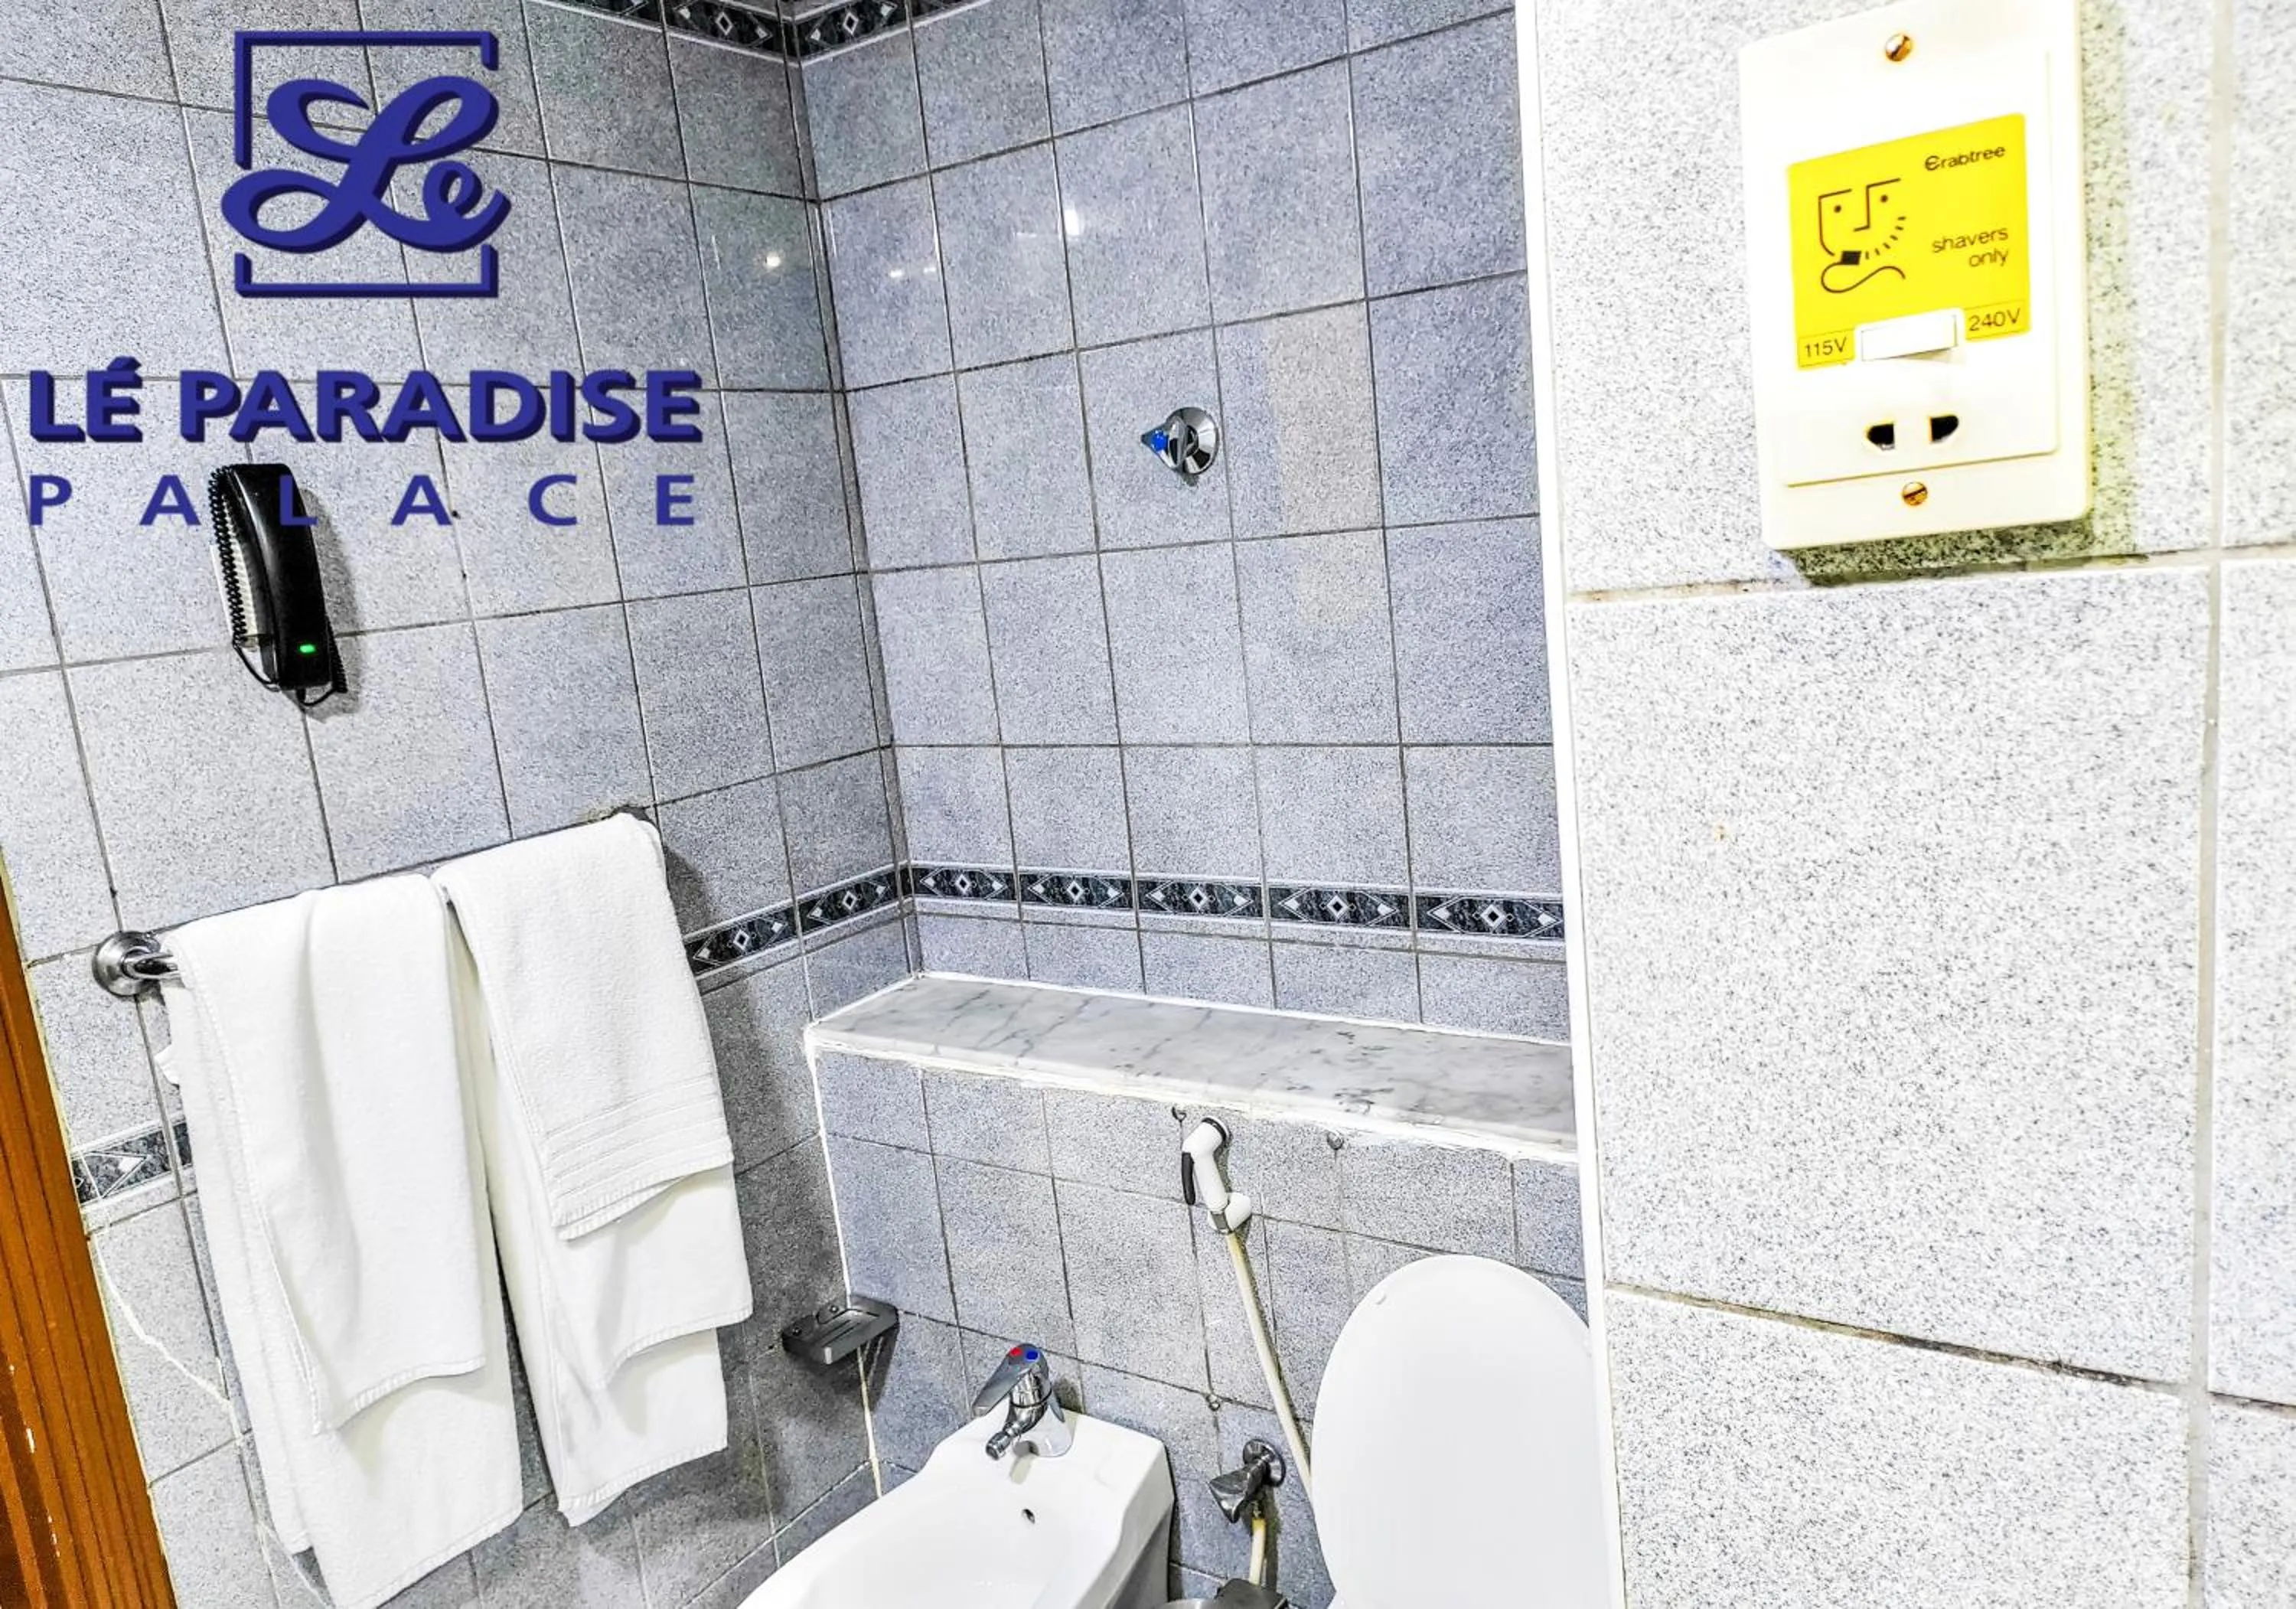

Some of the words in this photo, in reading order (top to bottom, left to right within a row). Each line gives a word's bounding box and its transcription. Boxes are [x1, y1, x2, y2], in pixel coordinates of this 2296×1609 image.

[1933, 227, 2009, 253] shavers
[1968, 249, 2009, 267] only
[1969, 308, 2021, 331] 240V
[1805, 338, 1848, 357] 115V
